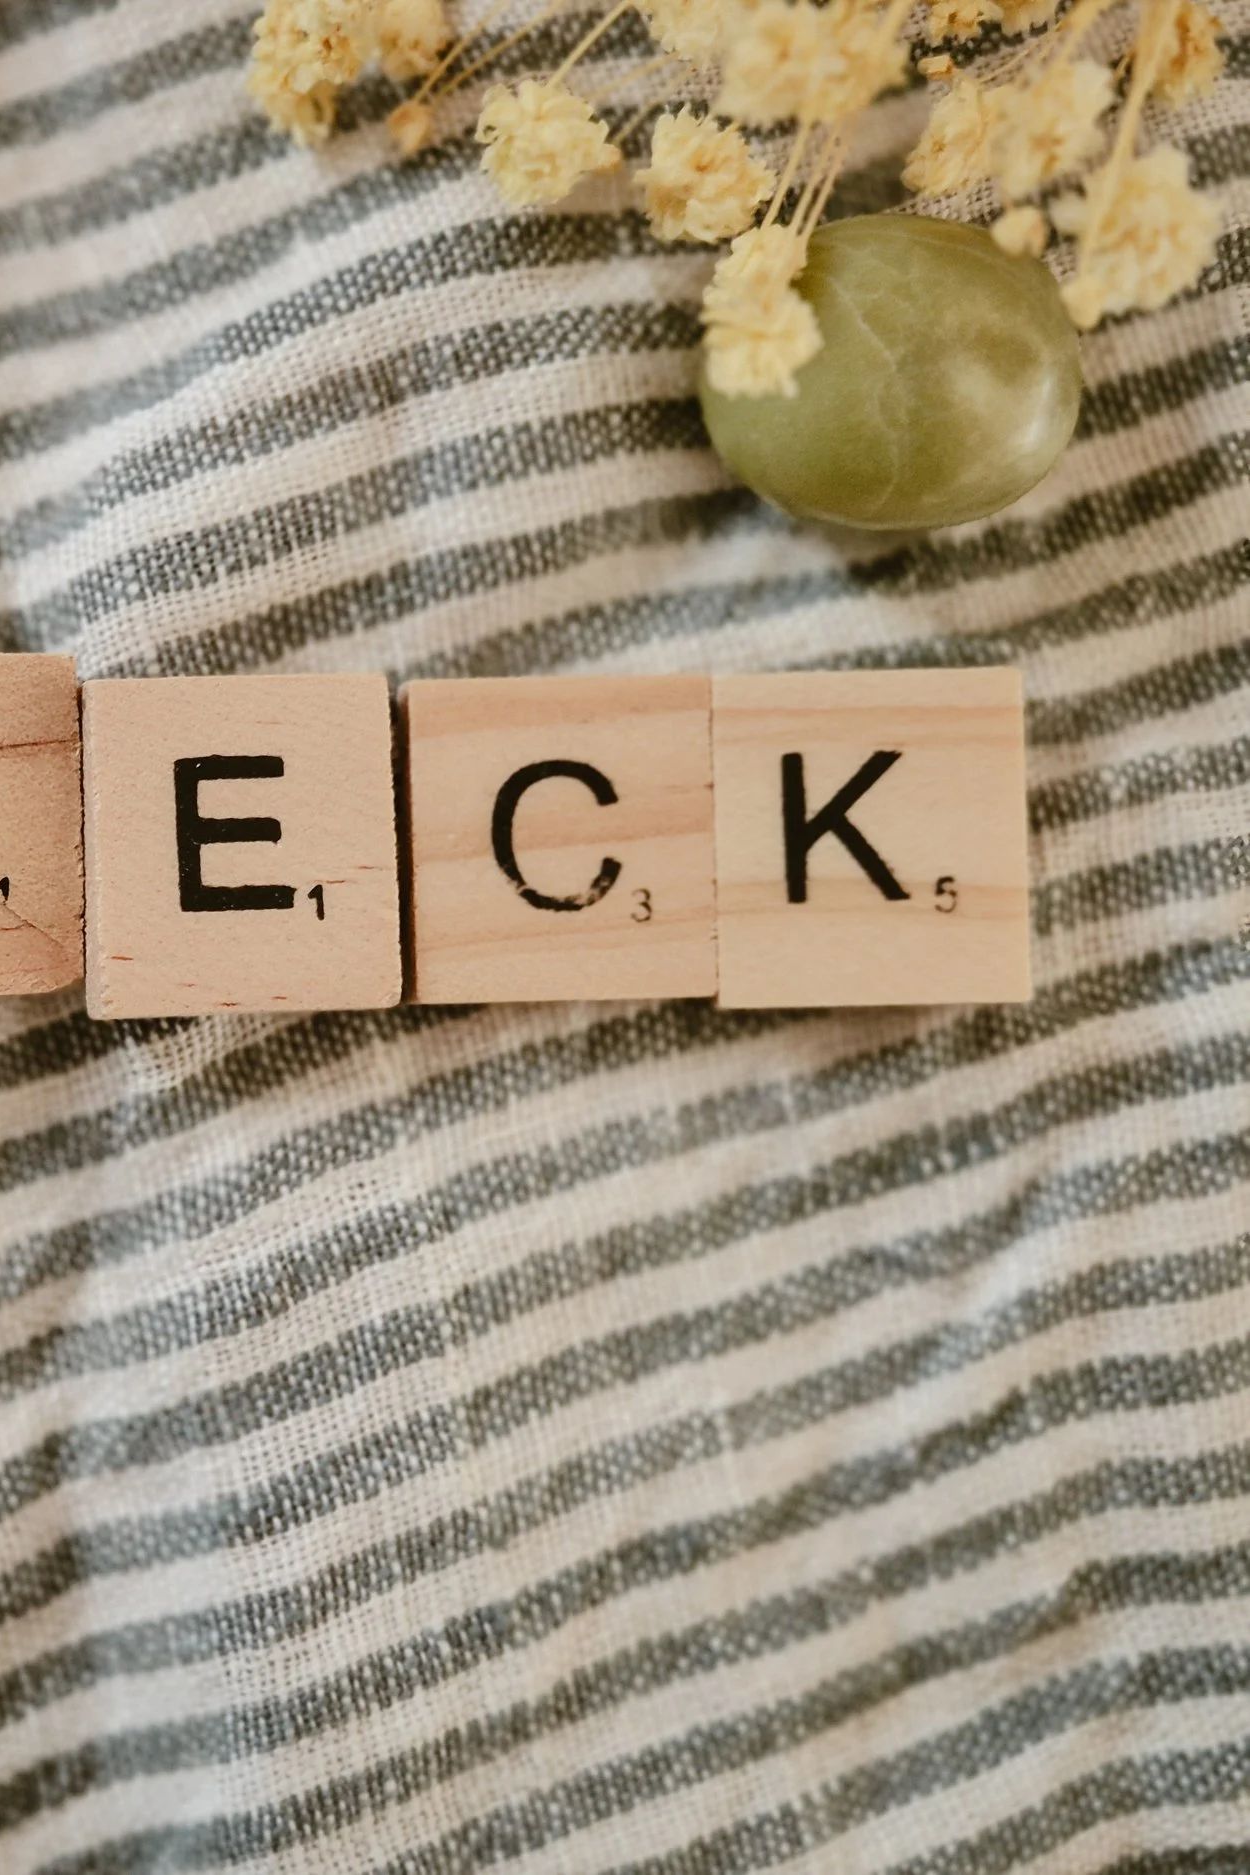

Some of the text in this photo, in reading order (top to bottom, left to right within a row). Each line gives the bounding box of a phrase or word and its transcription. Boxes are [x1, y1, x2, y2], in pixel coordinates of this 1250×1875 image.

[307, 884, 326, 921] 1
[631, 888, 654, 924] 3
[933, 876, 958, 914] 5
